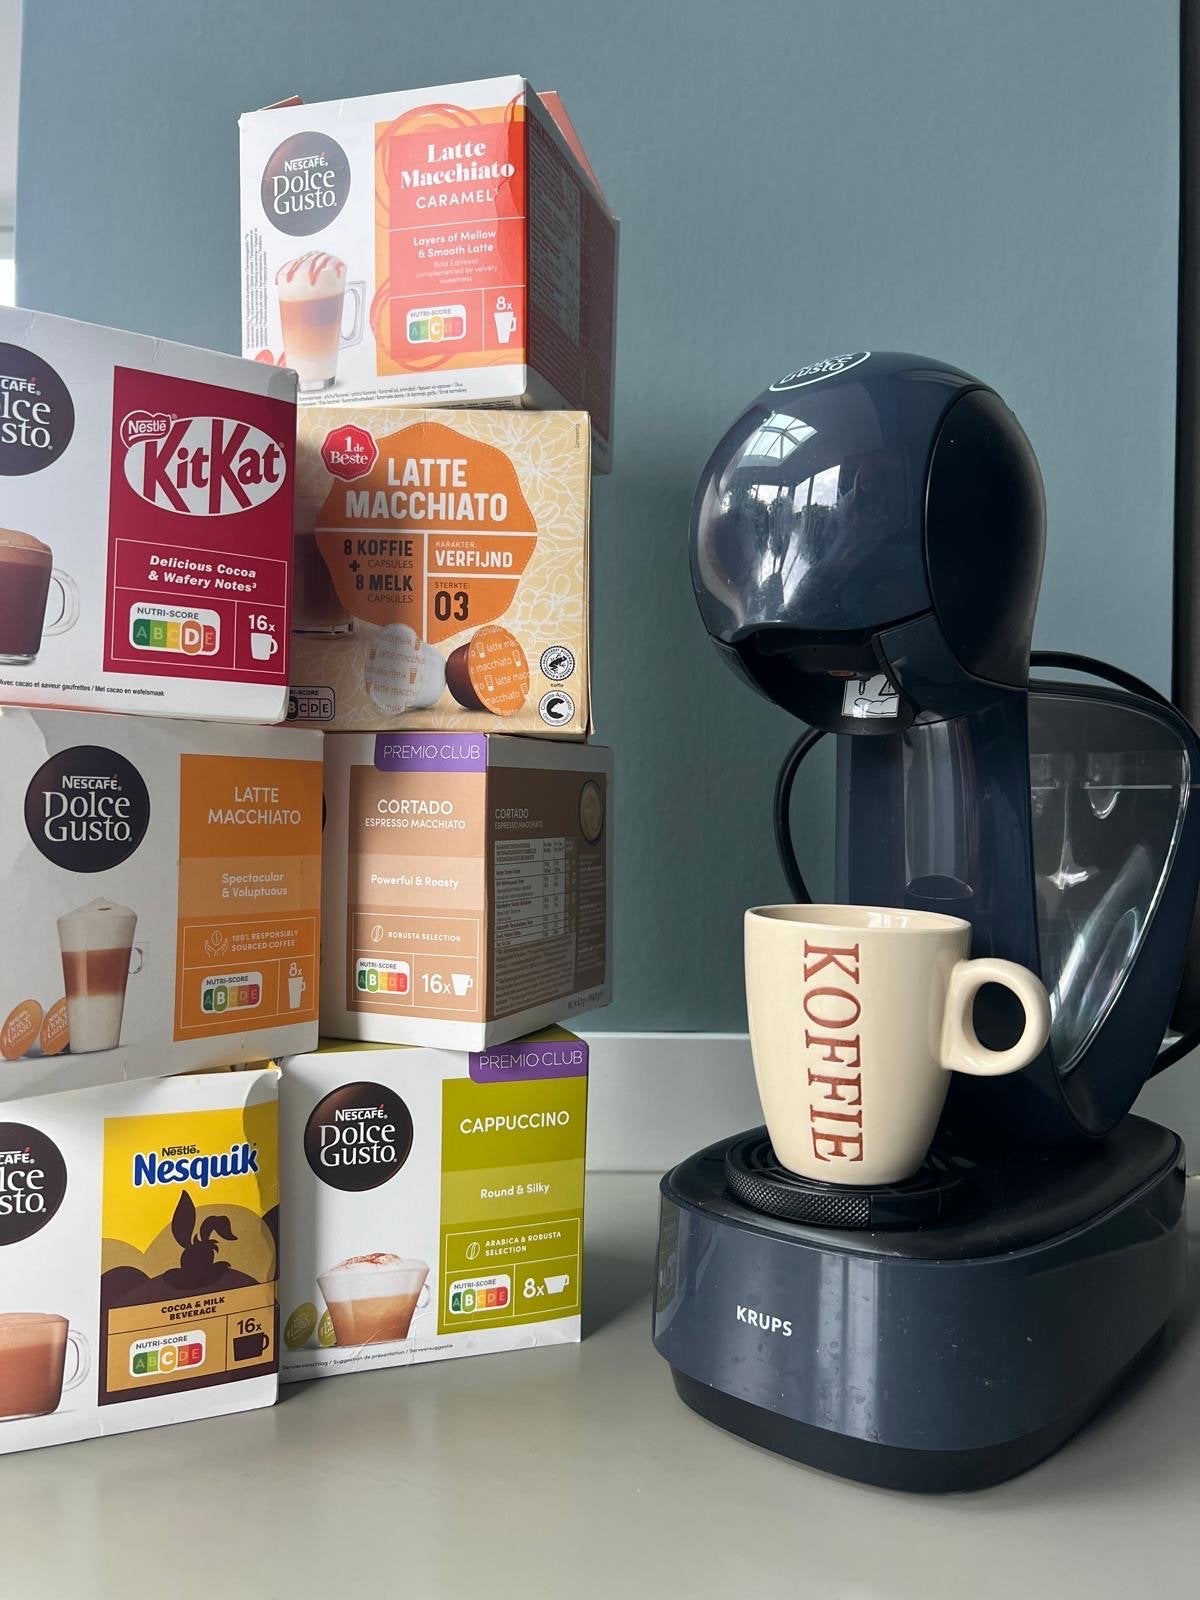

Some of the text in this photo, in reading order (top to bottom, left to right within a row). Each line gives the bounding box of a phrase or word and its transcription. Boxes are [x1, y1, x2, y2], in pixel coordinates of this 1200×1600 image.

[427, 142, 487, 163] Latte
[284, 152, 326, 172] NESCAFÉ
[400, 161, 515, 189] Macchiato
[272, 170, 336, 197] Dolce
[273, 188, 336, 215] Gusto
[413, 230, 496, 247] Layers of Mellow
[418, 243, 494, 259] & Smooth Latte
[496, 296, 513, 311] 8x
[410, 308, 451, 318] NUTRI-SCORE
[0, 377, 36, 394] CAFÉ
[0, 391, 51, 425] lce
[128, 420, 167, 434] Nestlé
[344, 436, 365, 453] 1 de
[330, 450, 368, 465] Beste
[143, 419, 280, 514] KitKat
[387, 457, 468, 488] LATTE
[346, 490, 508, 522] MACCHIATO
[344, 539, 414, 557] 8 KOFFIE
[149, 555, 256, 579] Delicious Cocoa
[368, 560, 414, 569] CAPSULES
[435, 550, 513, 568] VERFIJND
[148, 570, 159, 581] &
[163, 572, 211, 589] Wafery
[356, 574, 413, 592] 8 MELK
[368, 594, 413, 604] CAPSULES
[434, 591, 469, 622] 03
[137, 607, 199, 620] NUTRI-SCORE
[248, 614, 276, 632] 16x
[383, 745, 481, 759] PREMIO CLUB
[62, 774, 118, 790] NESCAFÉ
[235, 786, 279, 802] LATTE
[42, 791, 131, 818] Dolce
[377, 799, 453, 815] CORTADO
[208, 809, 301, 824] MACCHIATO
[494, 808, 529, 819] CORTADO
[44, 817, 131, 842] Gusto
[365, 818, 466, 830] ESPRESSO MACCHIATO
[494, 821, 518, 830] ESPRESSO
[222, 872, 285, 886] Spectacular
[371, 874, 459, 890] Powerful & Roasty
[222, 886, 288, 899] & Voluptuous
[251, 930, 299, 940] RESPONSIBLY
[388, 931, 461, 942] ROBUSTA SELECTION
[231, 942, 267, 952] SOURCED
[289, 962, 303, 977] 8x
[360, 961, 397, 970] NUTRI-SCORE
[206, 976, 249, 986] NUTRI-SCORE
[421, 973, 451, 995] 16x
[803, 940, 864, 1162] KOFFIE
[479, 1050, 583, 1070] PREMIO CLUB
[335, 1103, 384, 1122] NESCAFÉ
[460, 1110, 570, 1134] CAPPUCCINO
[318, 1121, 396, 1147] Dolce
[162, 1144, 197, 1157] Nestlé
[320, 1143, 396, 1167] Gusto
[133, 1143, 259, 1188] Nesquik
[480, 1182, 550, 1199] Round & Silky
[485, 1237, 519, 1247] ARABICA
[528, 1231, 561, 1242] ROBUSTA
[485, 1245, 527, 1257] SELECTION
[454, 1279, 496, 1290] NUTRI-SCORE
[523, 1278, 545, 1298] 8x
[161, 1303, 193, 1313] COCOA
[203, 1297, 225, 1306] MILK
[169, 1306, 217, 1320] BEVERAGE
[237, 1317, 262, 1335] 16x
[736, 1305, 792, 1337] KRUPS
[136, 1335, 188, 1350] NUTRI-SCORE
[333, 1356, 363, 1365] Suggestion
